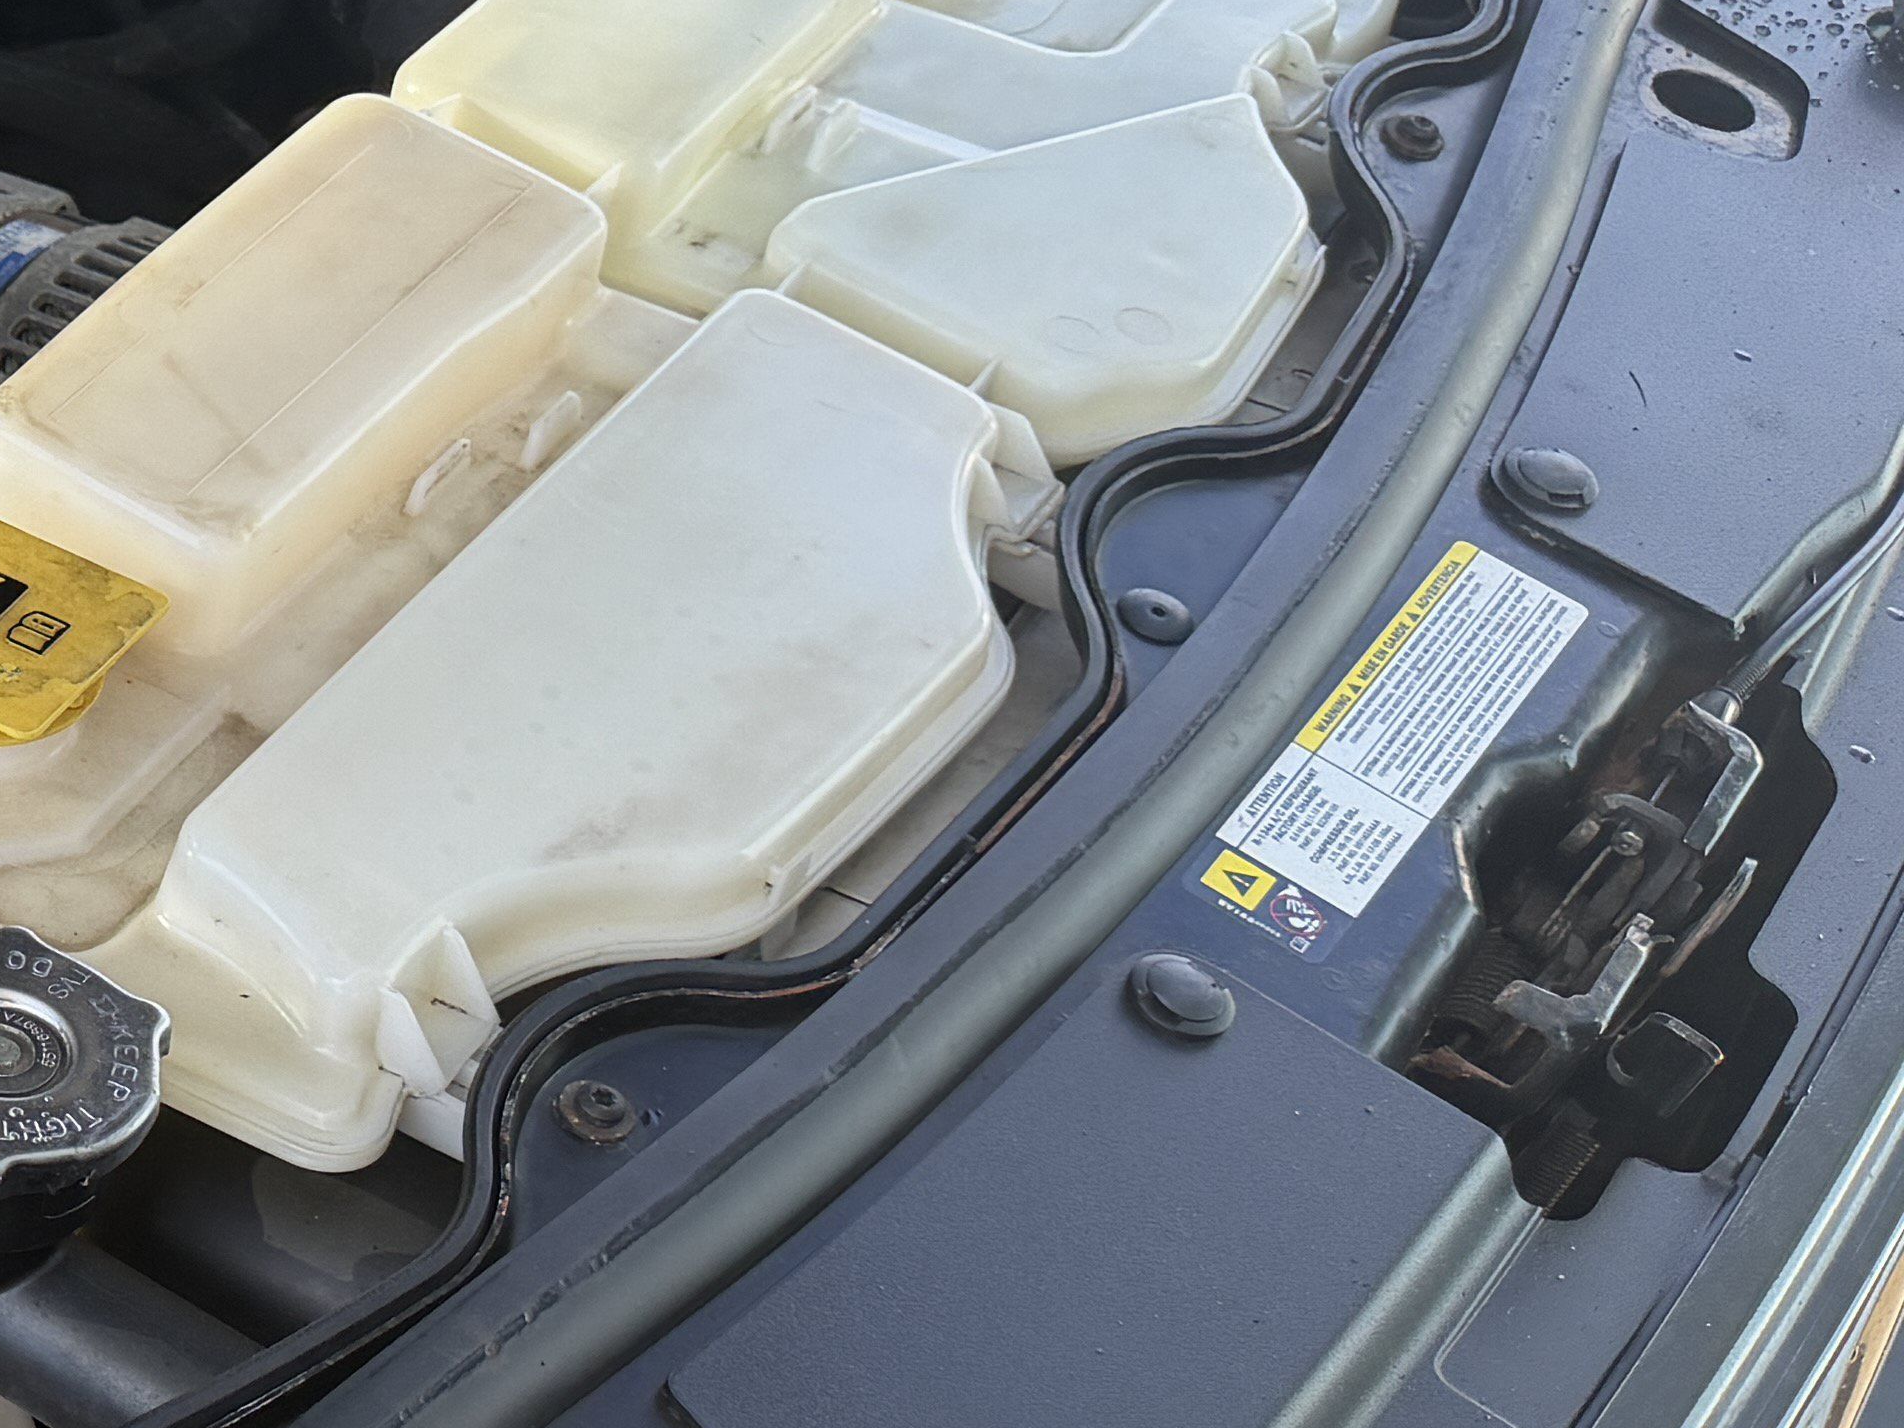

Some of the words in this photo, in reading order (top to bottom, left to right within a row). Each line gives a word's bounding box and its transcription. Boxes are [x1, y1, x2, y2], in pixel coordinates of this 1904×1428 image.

[1312, 691, 1353, 734] WARNING
[1355, 657, 1381, 682] MISE
[1371, 646, 1390, 662] EN
[1381, 619, 1411, 651] GARDE
[1413, 557, 1462, 611] ADVERTENCIA
[1243, 770, 1287, 818] ATTENTION
[5, 950, 53, 977] DO
[107, 1021, 139, 1102] KEEP
